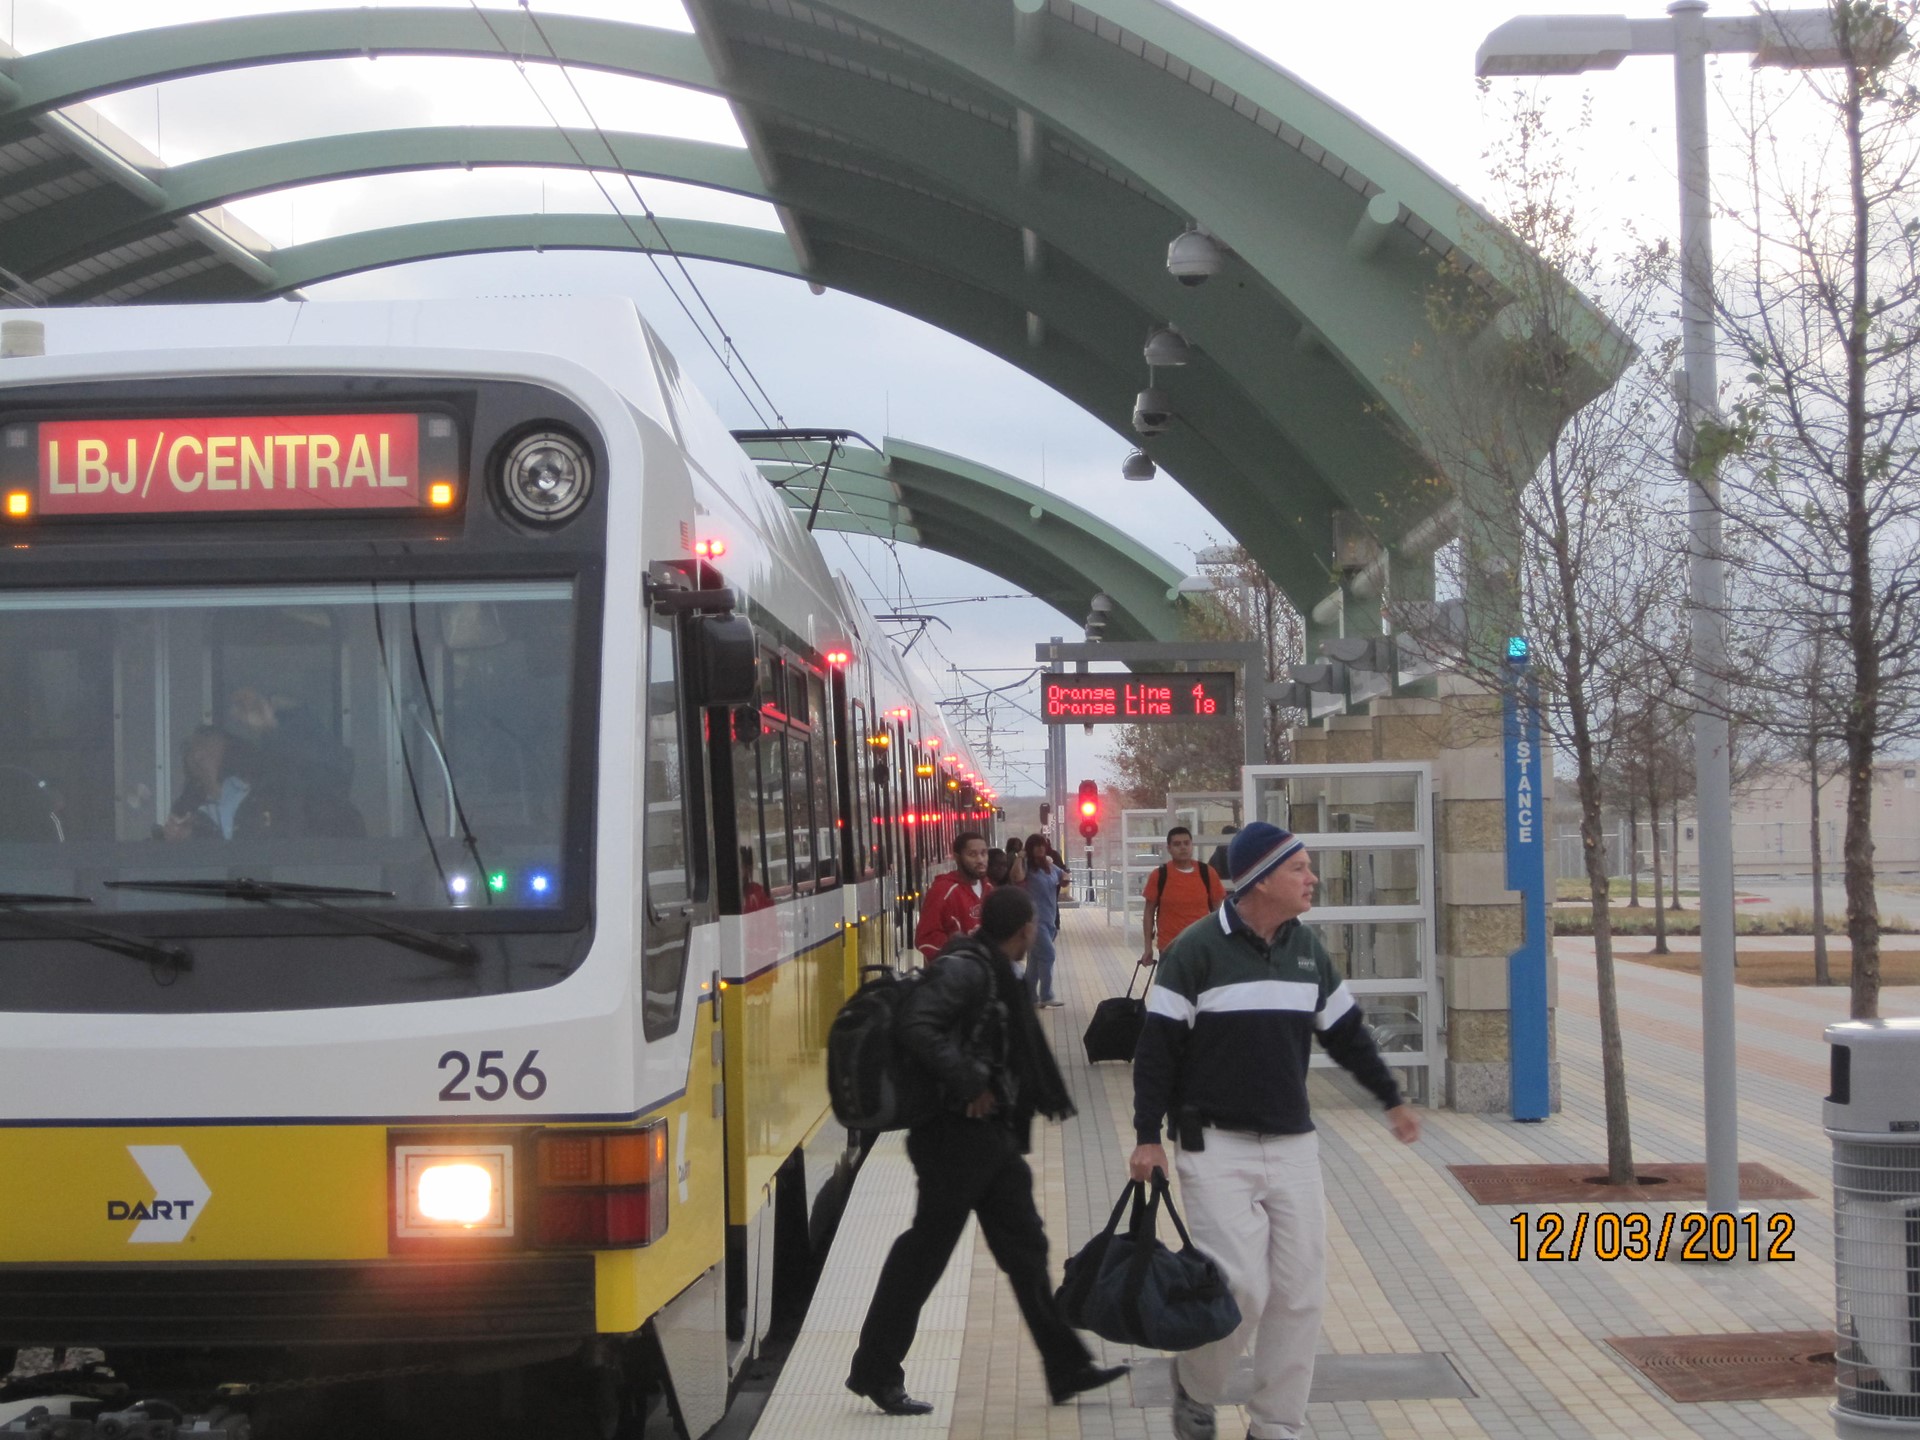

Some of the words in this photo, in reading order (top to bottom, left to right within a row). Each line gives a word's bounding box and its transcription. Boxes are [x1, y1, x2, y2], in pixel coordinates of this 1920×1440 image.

[48, 431, 408, 498] LBJ/CENTRAL
[1049, 685, 1116, 700] Orange
[1125, 684, 1171, 700] Line
[1192, 684, 1204, 699] 4
[1049, 700, 1116, 715] Orange
[1125, 699, 1171, 715] Line
[1195, 699, 1216, 714] 18
[438, 1050, 547, 1102] 256
[107, 1200, 195, 1221] DART
